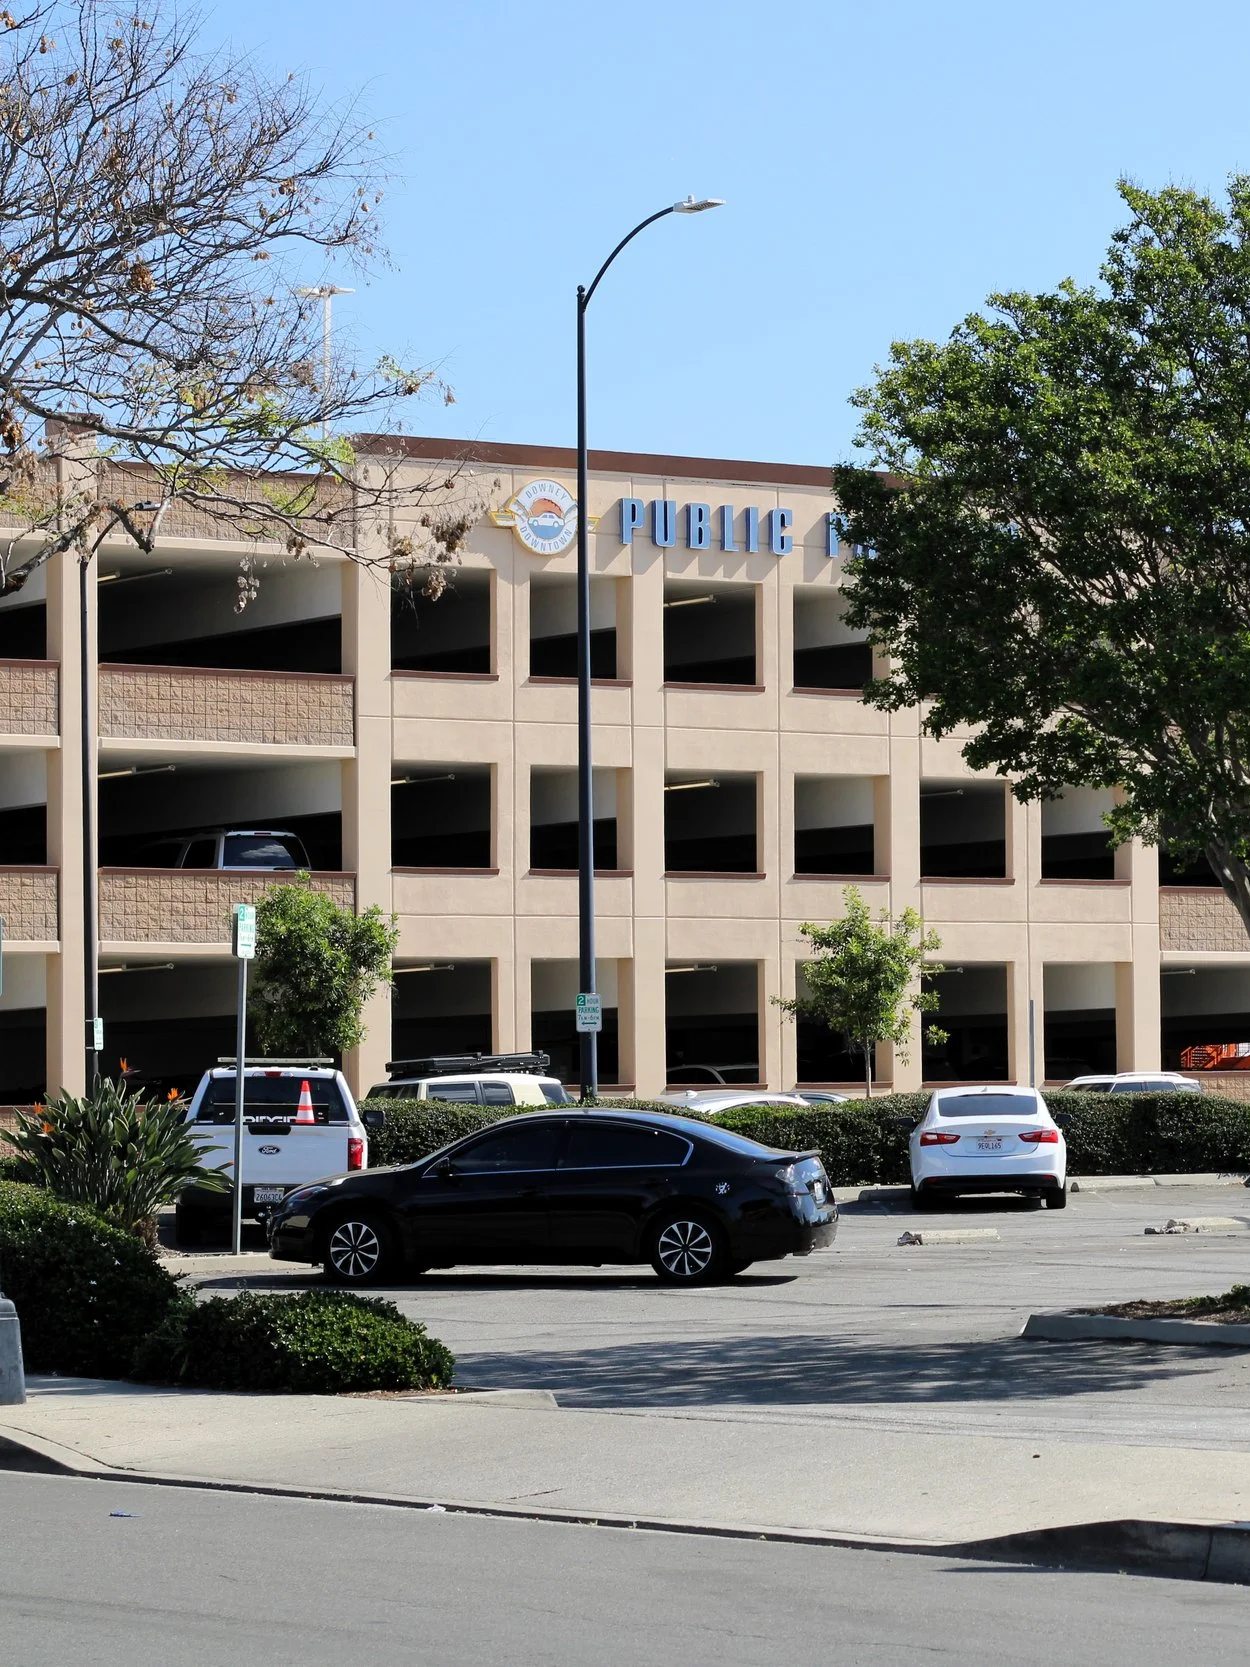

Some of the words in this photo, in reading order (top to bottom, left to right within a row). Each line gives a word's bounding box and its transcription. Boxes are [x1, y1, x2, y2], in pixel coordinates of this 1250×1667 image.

[525, 483, 567, 500] DOWNEY
[619, 498, 793, 556] PUBLIC
[520, 526, 573, 552] DOWNTOWN
[577, 995, 585, 1005] 2
